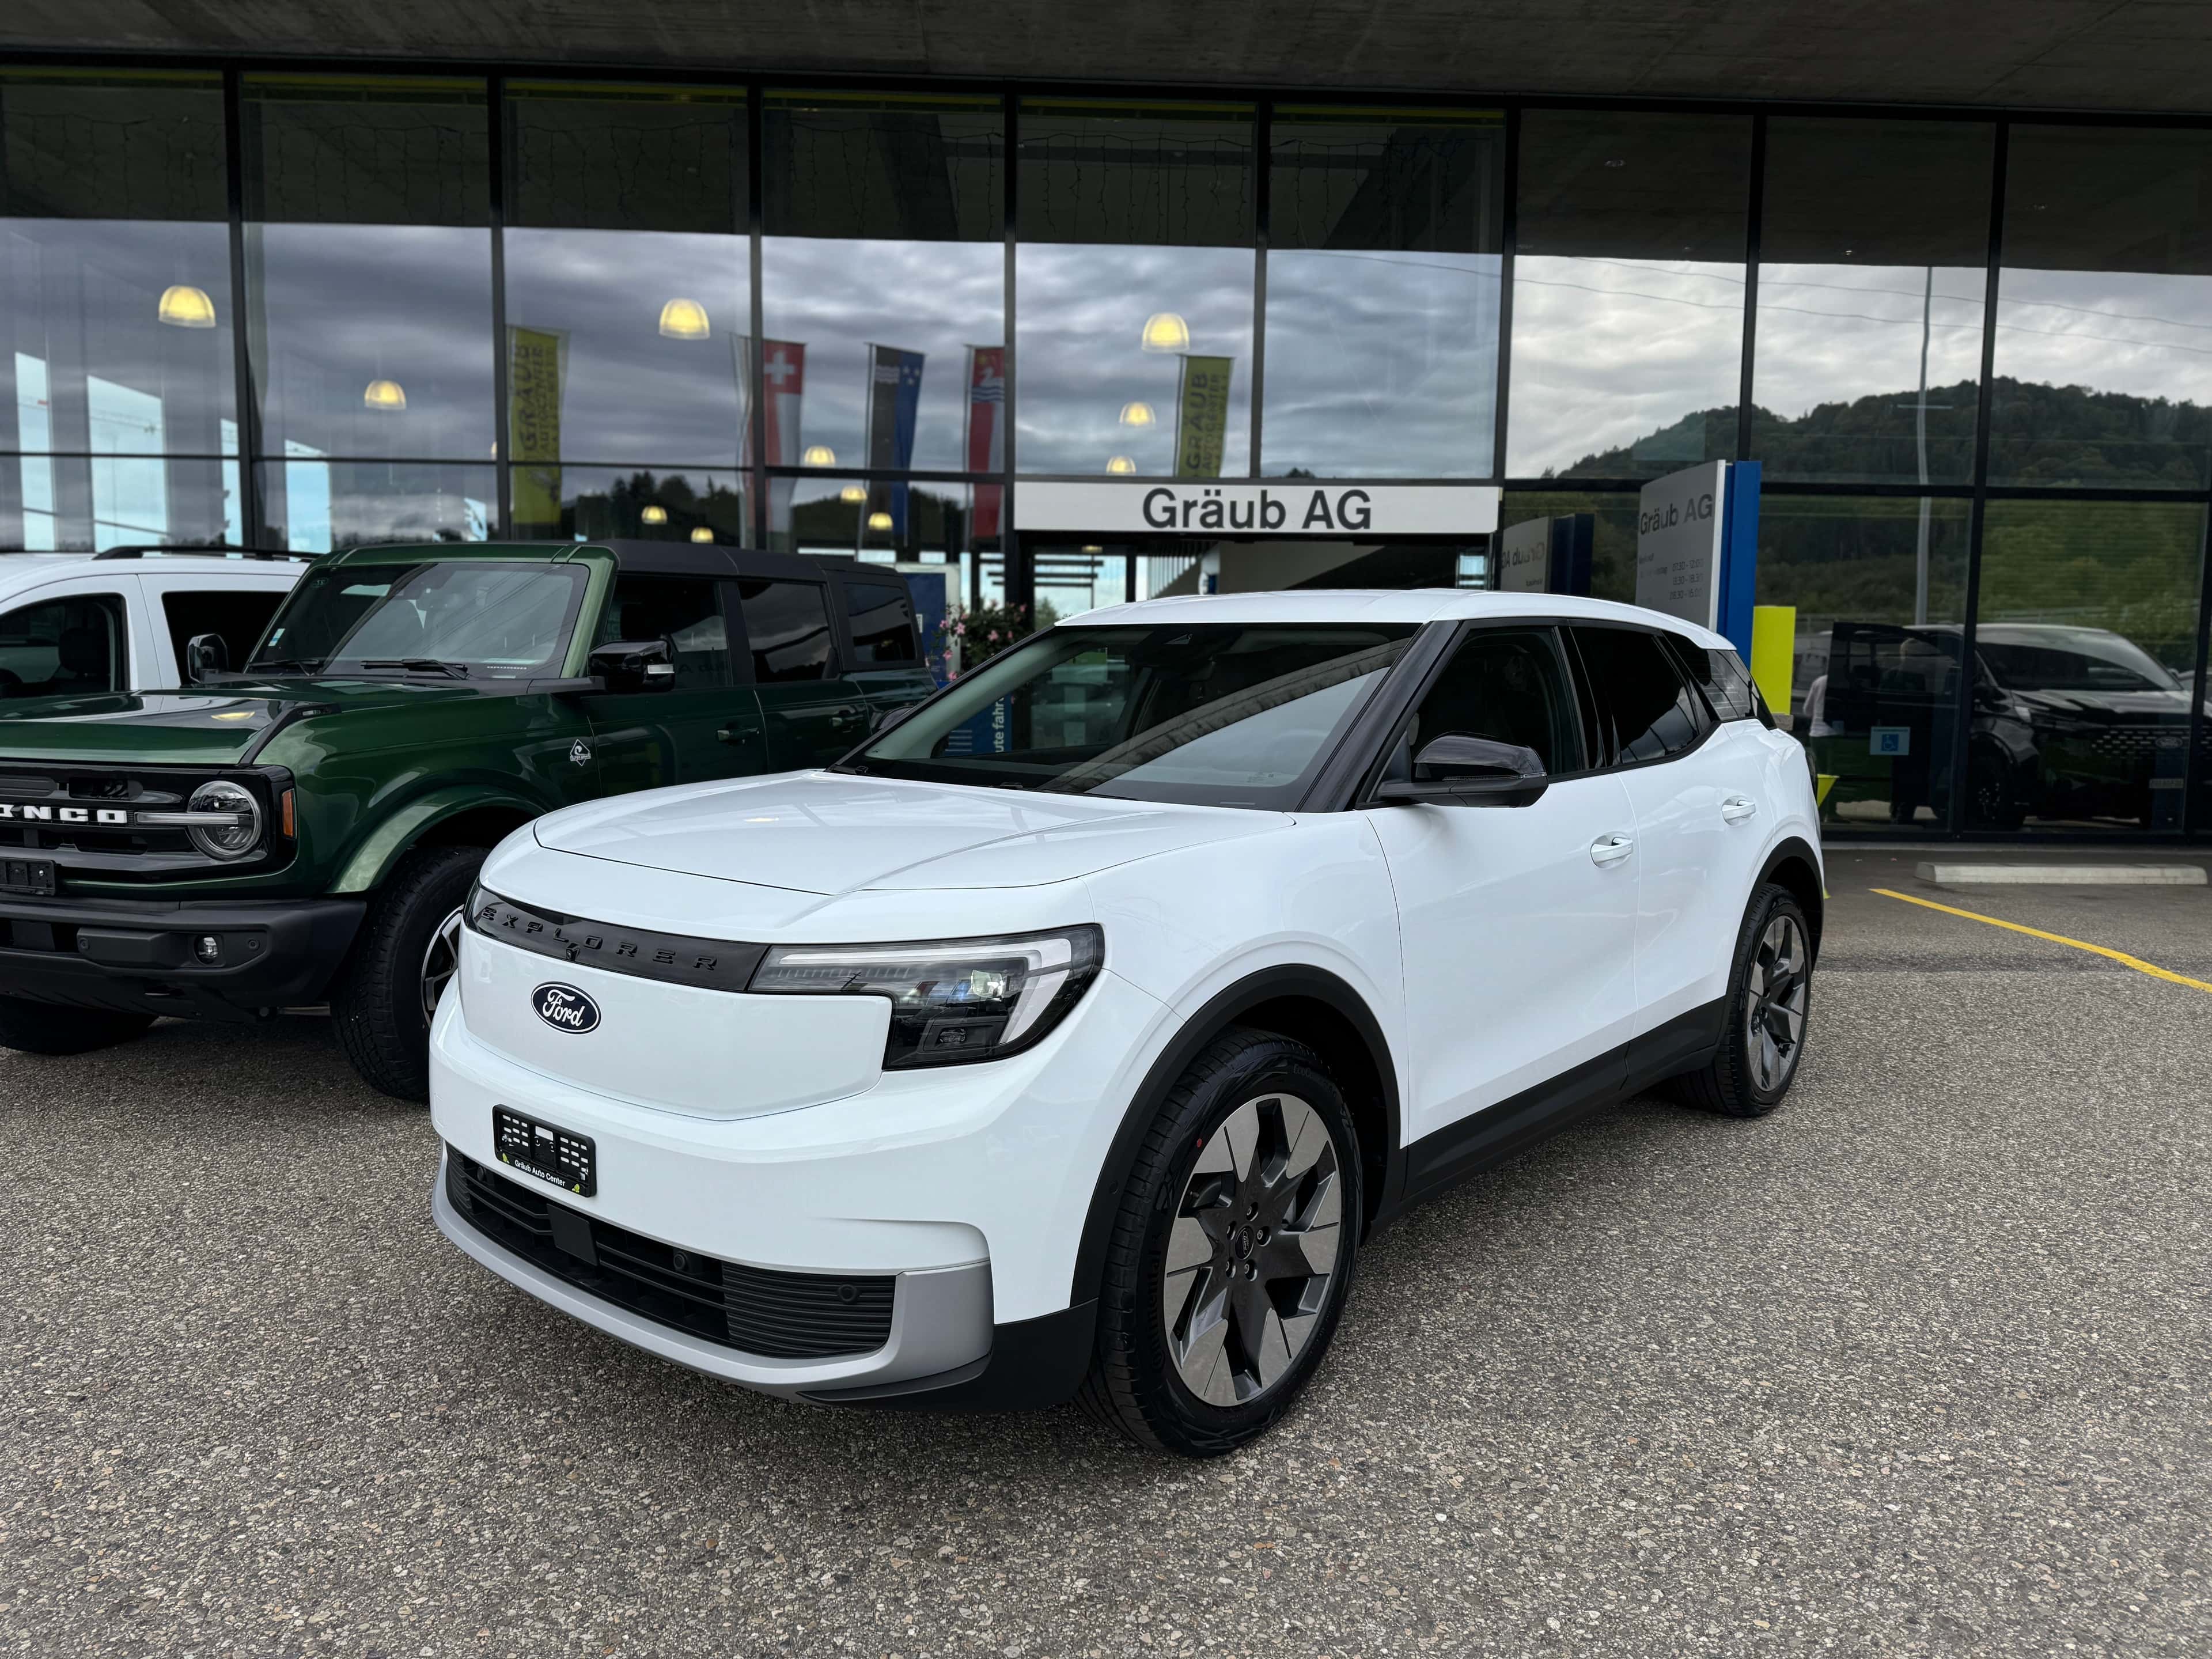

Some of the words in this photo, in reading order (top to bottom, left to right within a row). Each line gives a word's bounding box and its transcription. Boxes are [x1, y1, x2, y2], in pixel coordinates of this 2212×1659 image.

[1184, 371, 1209, 470] GRÄUB
[1142, 487, 1286, 529] Gräub
[1301, 488, 1371, 530] AG
[1640, 502, 1679, 535] Gräub
[1683, 493, 1713, 524] AG
[992, 697, 1004, 729] fahr
[481, 906, 718, 971] EXPLORER
[541, 988, 586, 1028] Ford
[514, 1159, 532, 1173] Gräub
[532, 1166, 545, 1179] Auto
[547, 1172, 566, 1187] Center
